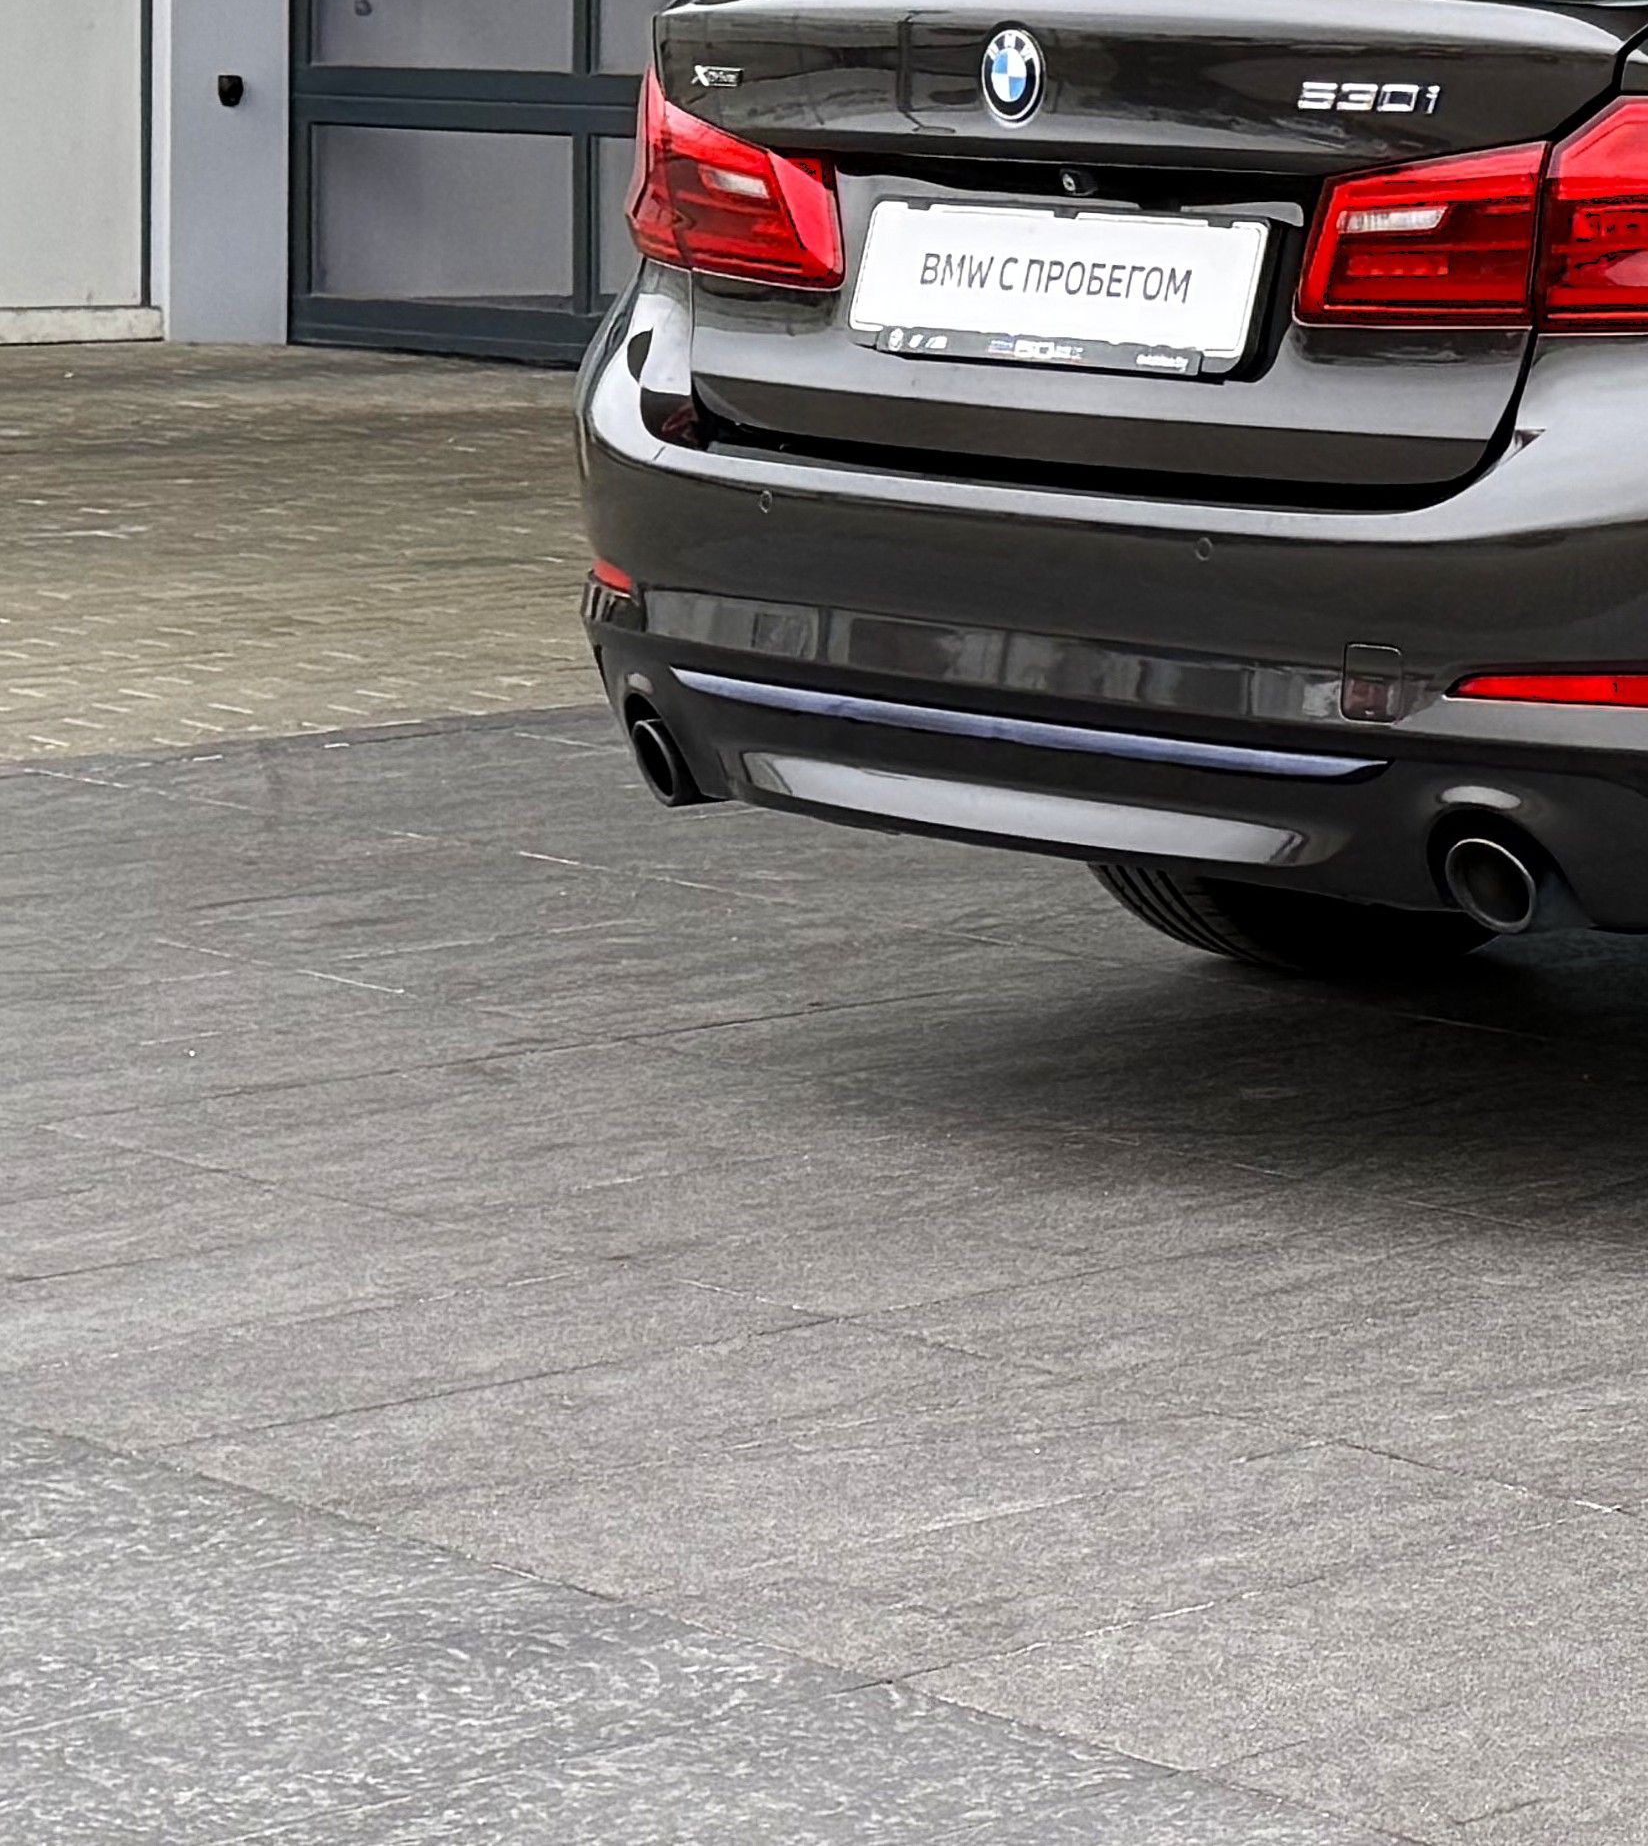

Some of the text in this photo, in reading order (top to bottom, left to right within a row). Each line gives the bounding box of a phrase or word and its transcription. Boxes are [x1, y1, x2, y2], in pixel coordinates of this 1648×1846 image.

[1297, 81, 1441, 114] 530i
[919, 252, 995, 289] BMW
[1022, 258, 1193, 304] ПРОБЕГОМ
